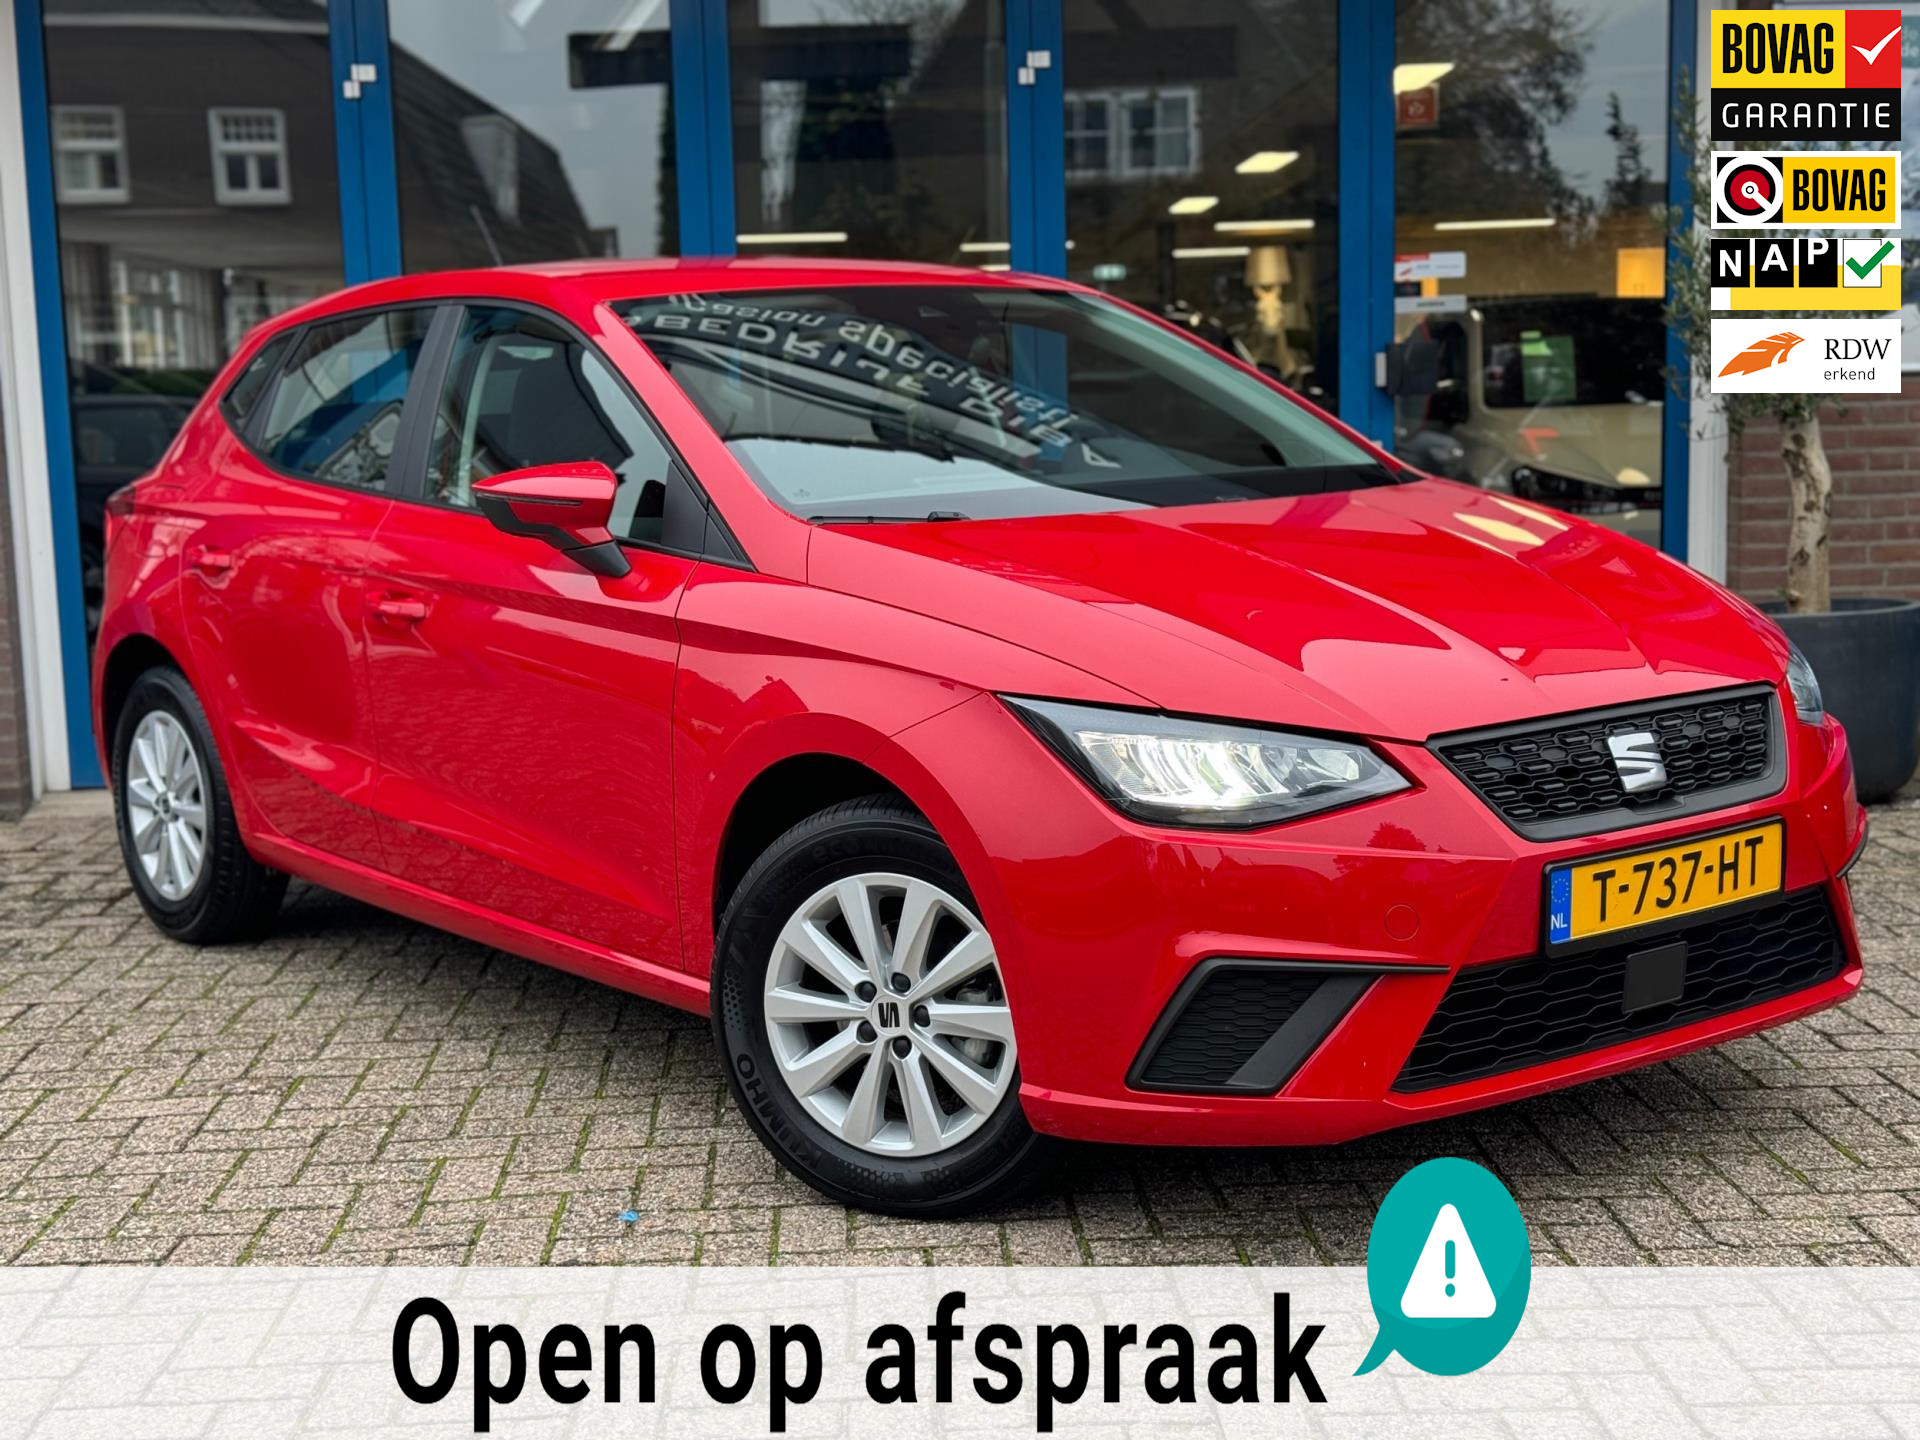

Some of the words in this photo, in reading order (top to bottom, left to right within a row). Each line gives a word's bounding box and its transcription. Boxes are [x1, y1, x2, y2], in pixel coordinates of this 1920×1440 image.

[1550, 913, 1568, 931] NL
[1592, 836, 1764, 922] T-737-HT
[736, 1053, 822, 1170] KUMHO
